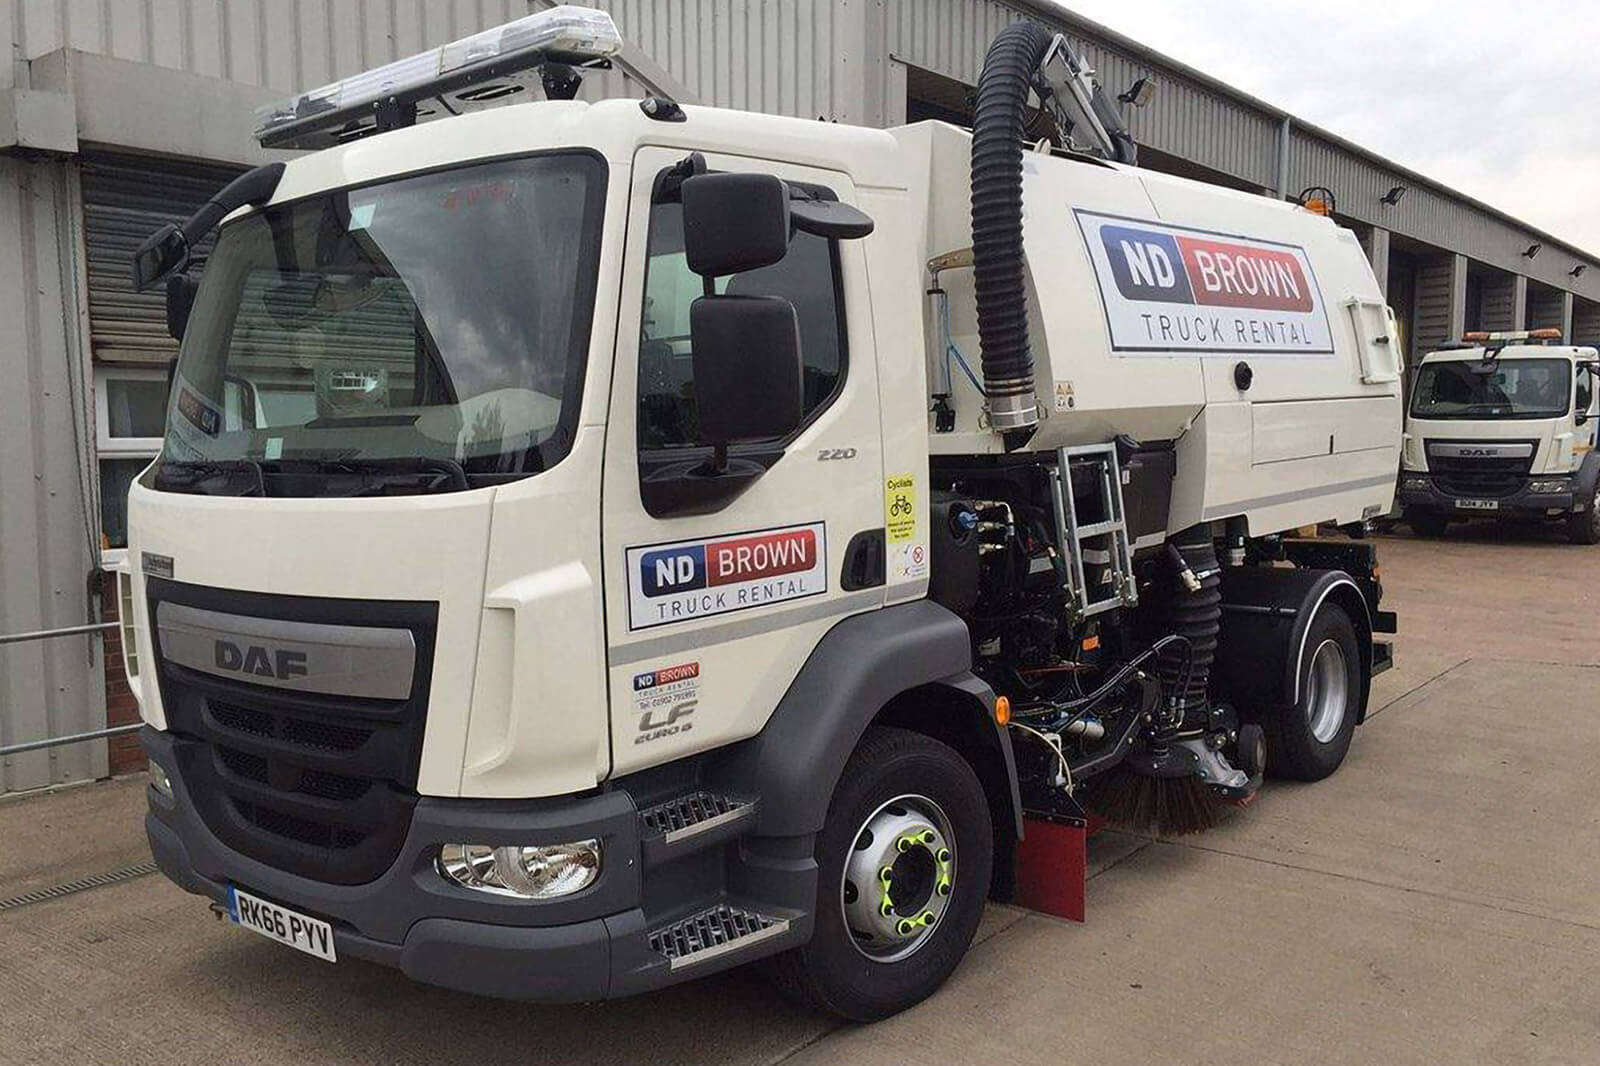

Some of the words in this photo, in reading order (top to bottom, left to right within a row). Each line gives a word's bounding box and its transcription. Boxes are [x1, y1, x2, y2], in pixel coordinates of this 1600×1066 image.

[1120, 239, 1176, 288] ND
[1193, 250, 1301, 300] BROWN
[1141, 314, 1224, 343] TRUCK
[1235, 319, 1312, 345] RENTAL
[817, 448, 857, 461] 220
[655, 555, 694, 588] ND
[719, 538, 806, 577] BROWN
[657, 592, 726, 619] TRUCK
[738, 578, 807, 604] RENTAL
[215, 640, 307, 680] DAF
[638, 675, 653, 688] ND
[660, 665, 697, 682] BROWN
[639, 700, 698, 731] LF
[634, 726, 679, 744] EURO
[681, 723, 692, 732] 6
[239, 895, 286, 938] RK66
[289, 915, 327, 954] PYV
